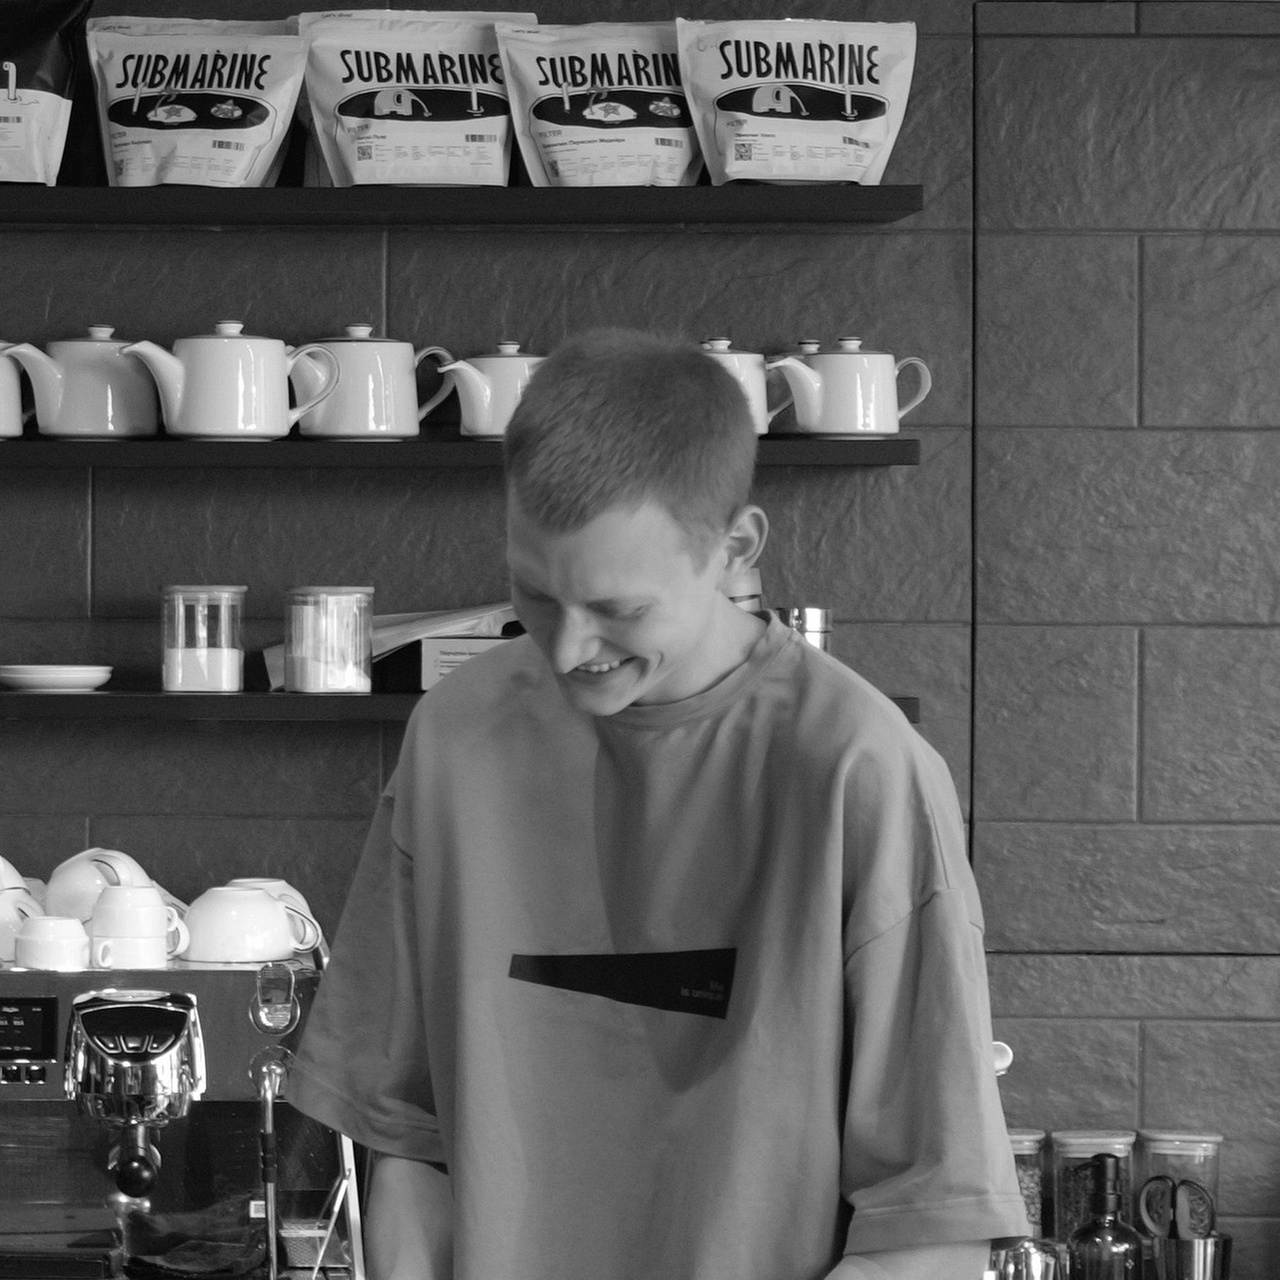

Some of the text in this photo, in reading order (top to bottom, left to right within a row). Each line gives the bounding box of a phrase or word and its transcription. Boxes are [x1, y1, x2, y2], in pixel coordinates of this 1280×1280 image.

[116, 52, 272, 90] SUBMARINE
[340, 49, 505, 85] SUBMARINE
[535, 52, 682, 88] SUBMARIN
[719, 39, 881, 86] SUBMARINE
